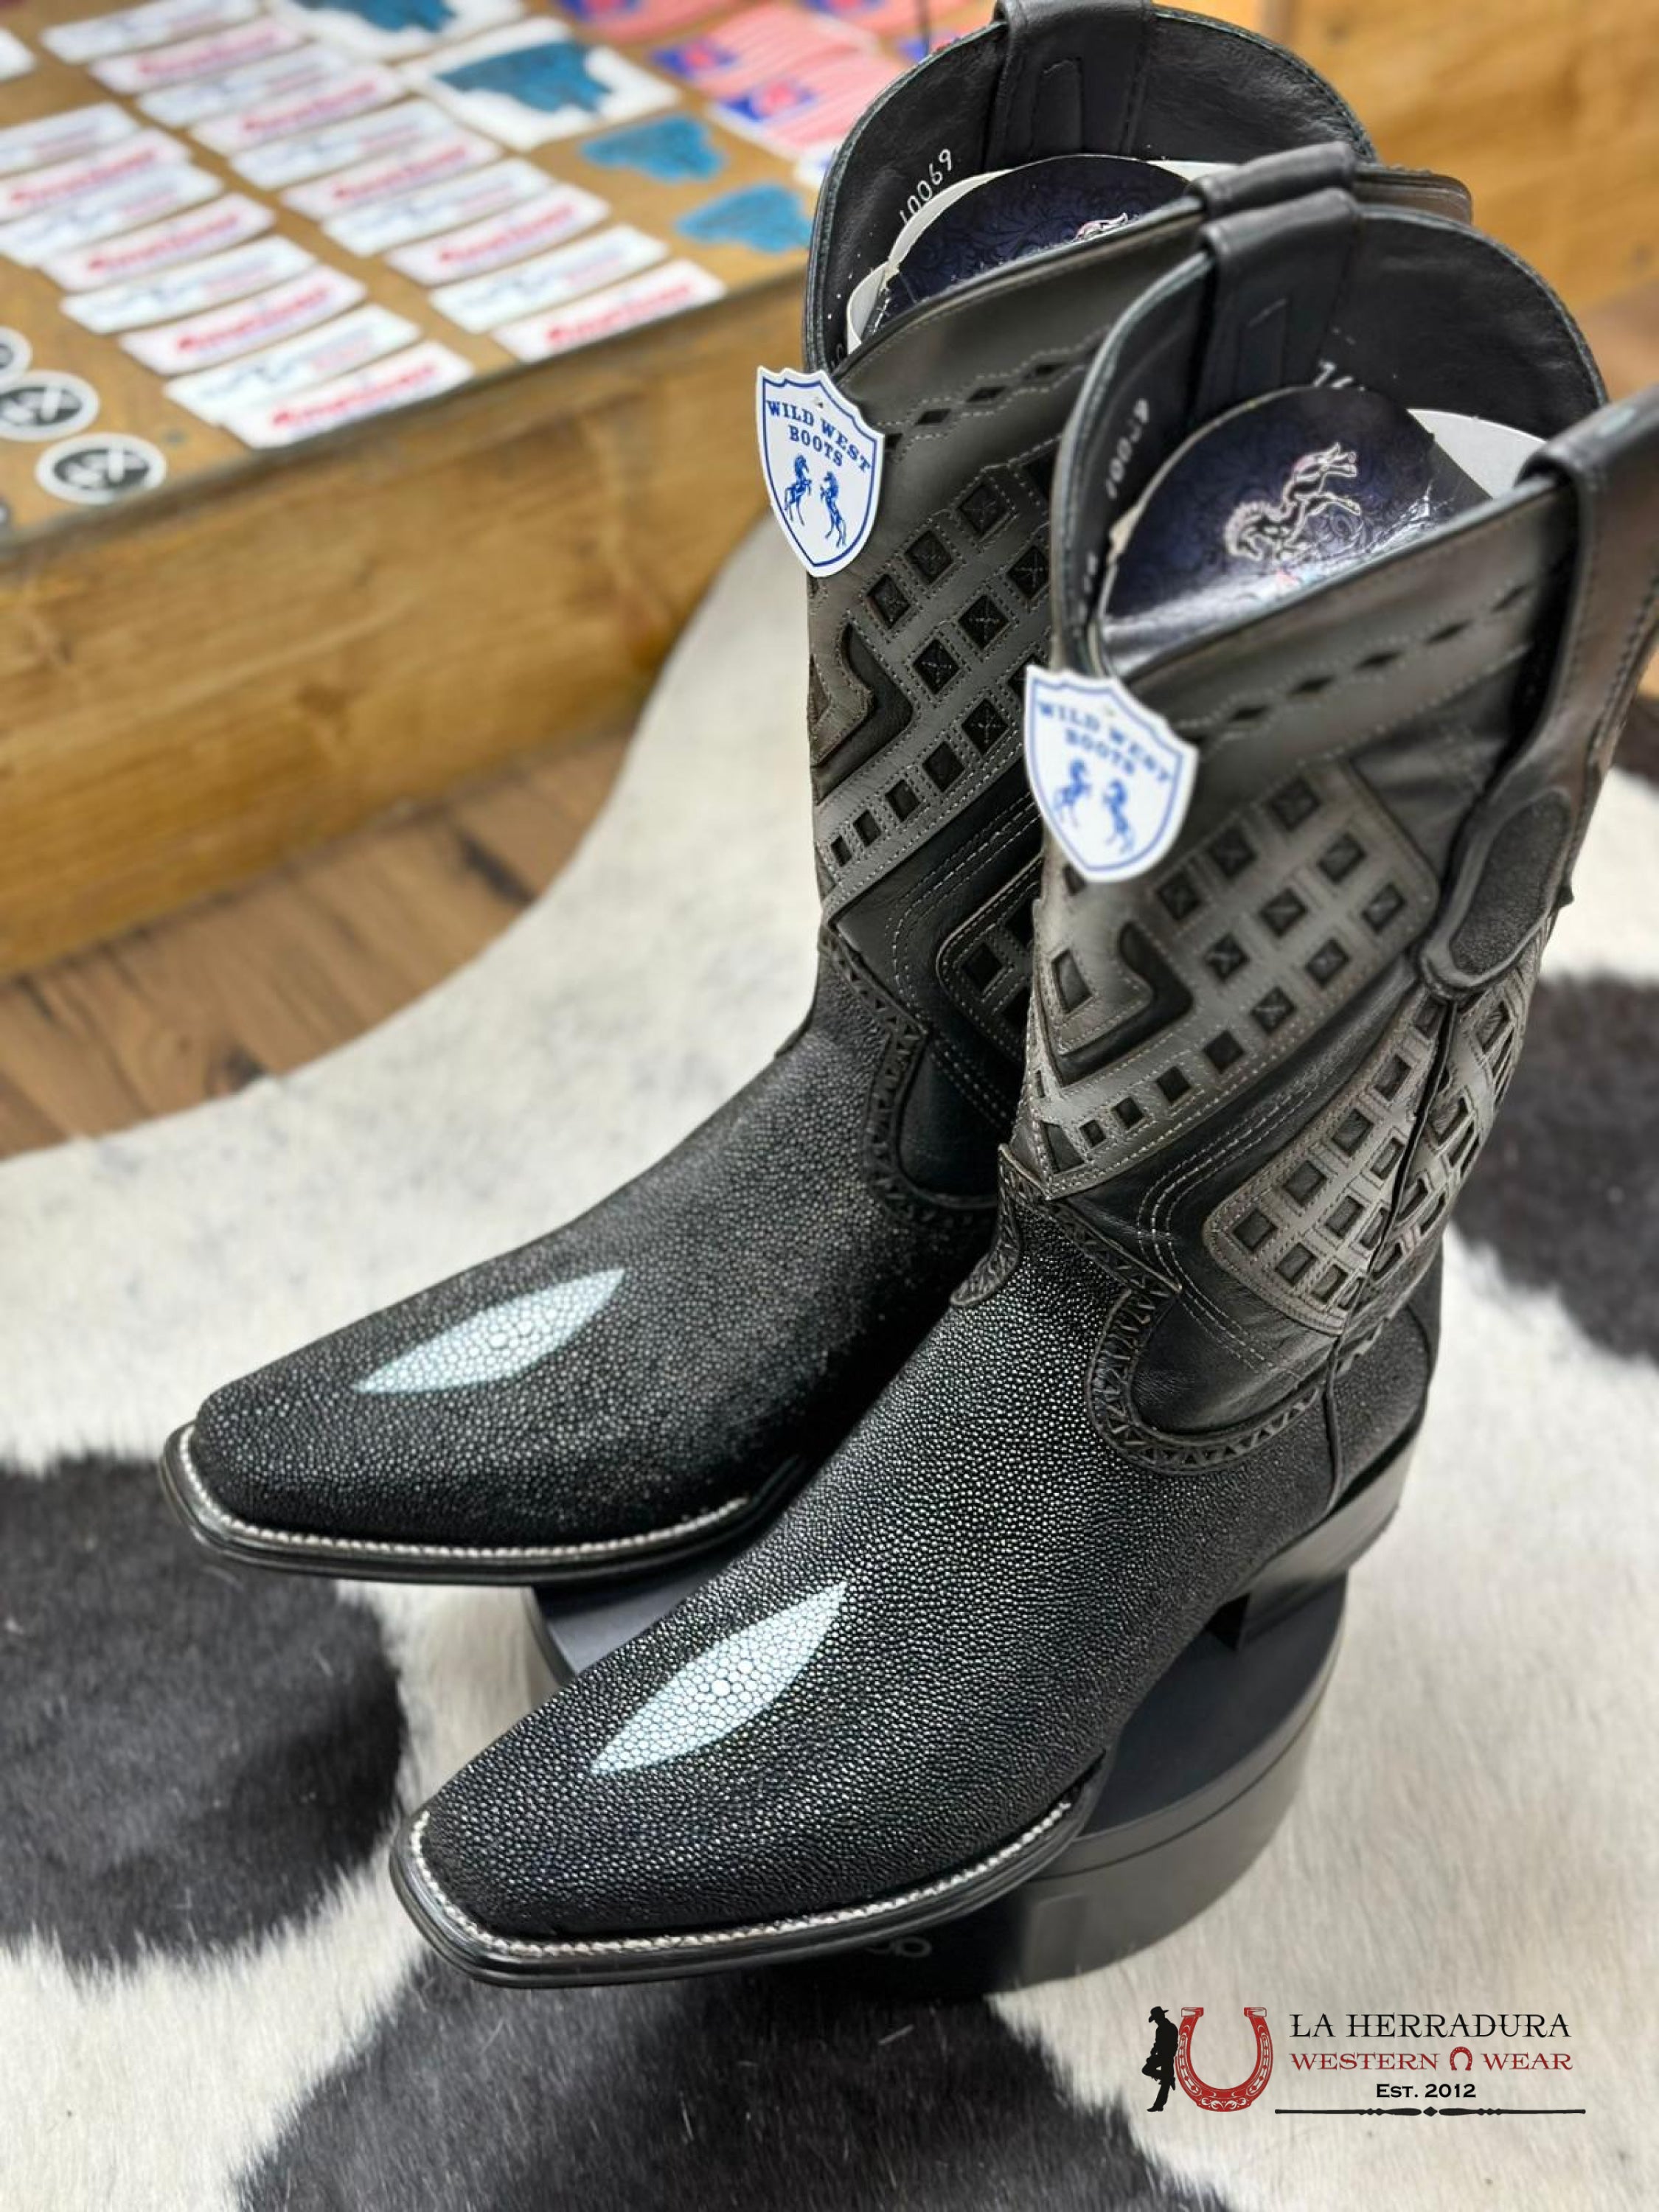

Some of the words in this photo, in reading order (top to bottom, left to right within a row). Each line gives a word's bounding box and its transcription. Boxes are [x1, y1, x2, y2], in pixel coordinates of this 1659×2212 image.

[767, 400, 814, 426] WILD
[819, 418, 871, 474] WEST
[787, 425, 845, 467] BOOTS
[1037, 700, 1100, 731] WILD
[1065, 728, 1135, 776] BOOTS
